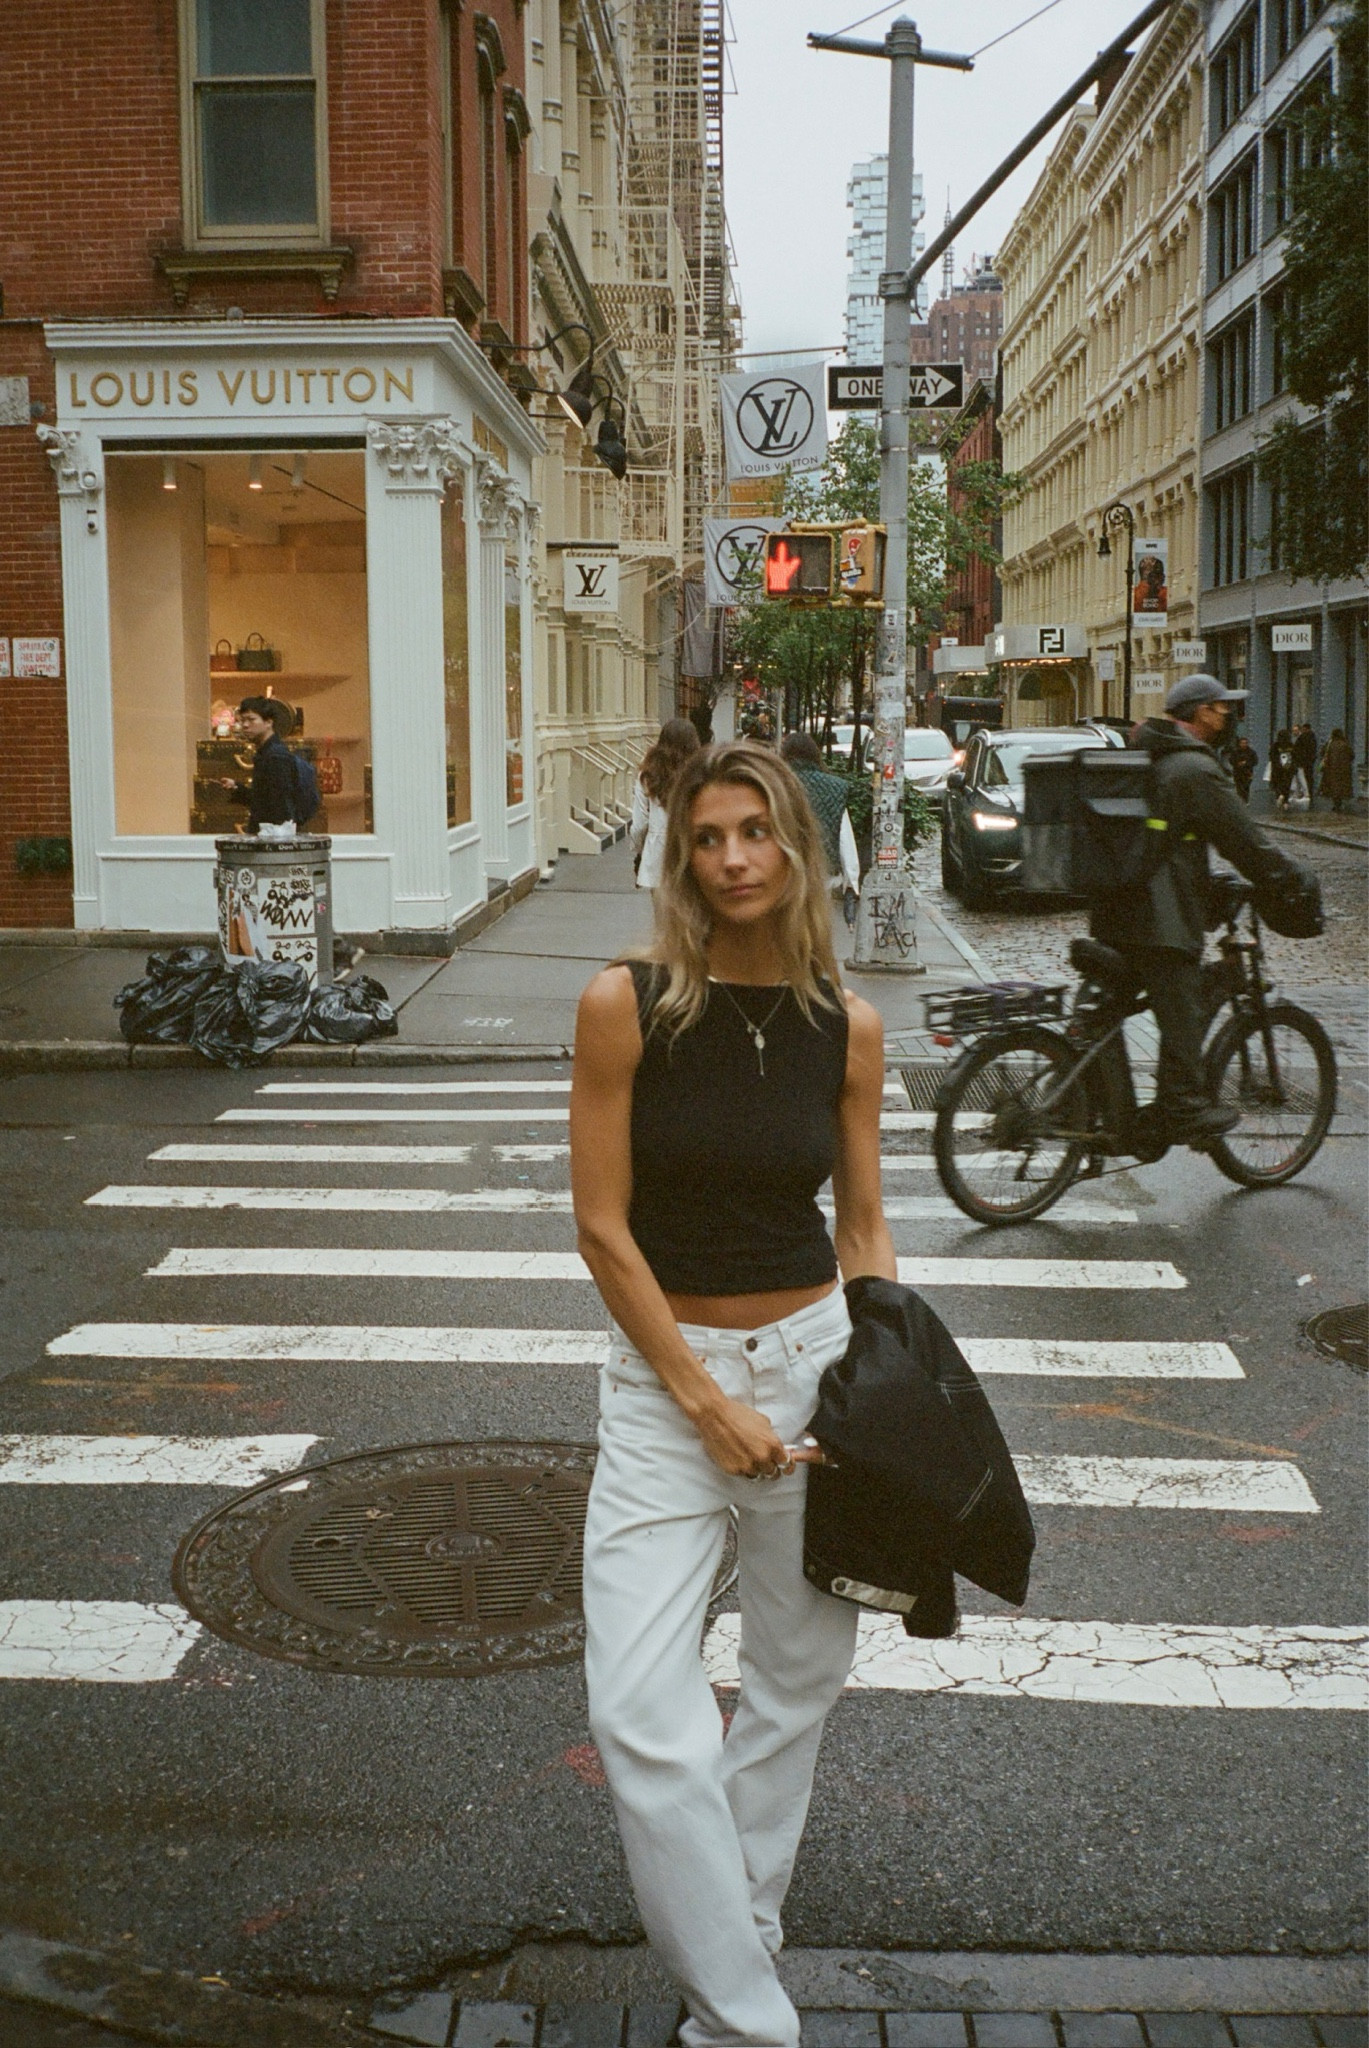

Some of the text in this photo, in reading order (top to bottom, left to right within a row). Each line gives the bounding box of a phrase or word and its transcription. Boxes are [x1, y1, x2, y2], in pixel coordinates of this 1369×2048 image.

[70, 366, 415, 408] LOUIS VUITTON
[847, 379, 883, 396] ONE
[740, 463, 771, 474] LOUIS
[1275, 632, 1309, 644] DIOR
[1176, 646, 1204, 657] DIOR
[1136, 680, 1163, 688] DIOR
